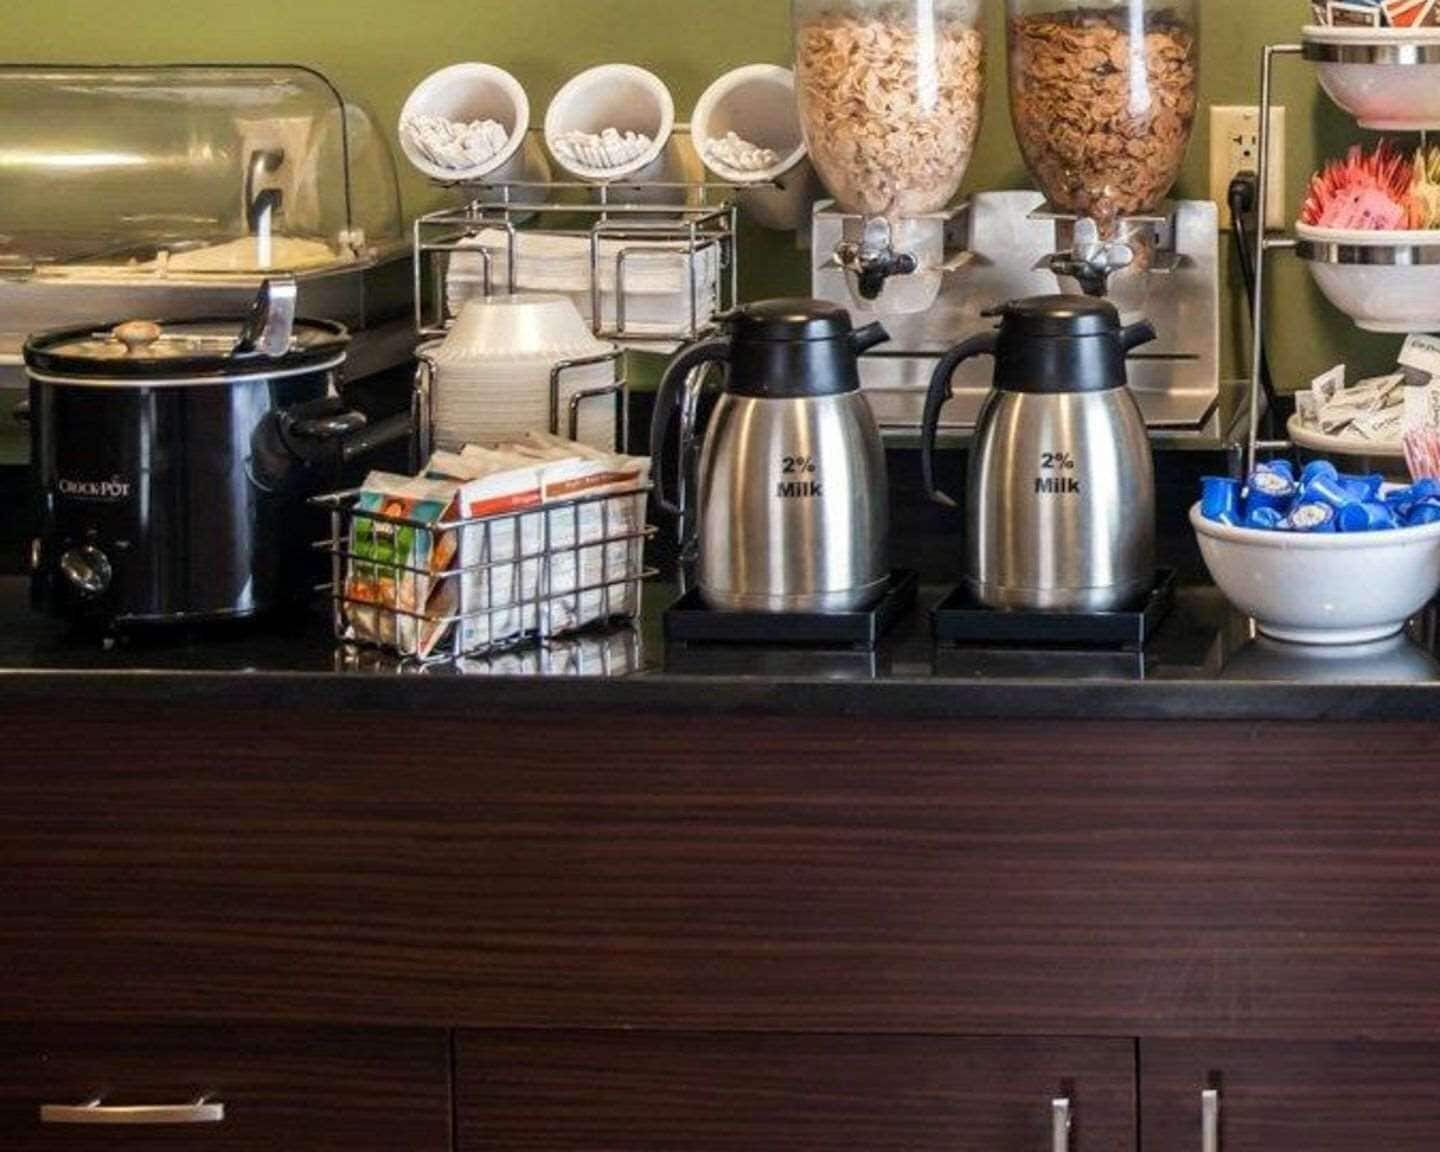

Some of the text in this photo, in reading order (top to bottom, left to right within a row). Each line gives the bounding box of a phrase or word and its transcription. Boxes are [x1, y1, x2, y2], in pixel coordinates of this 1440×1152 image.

[782, 455, 816, 473] 2%
[1041, 452, 1075, 469] 2%
[776, 481, 823, 497] Milk
[1034, 477, 1081, 494] Milk
